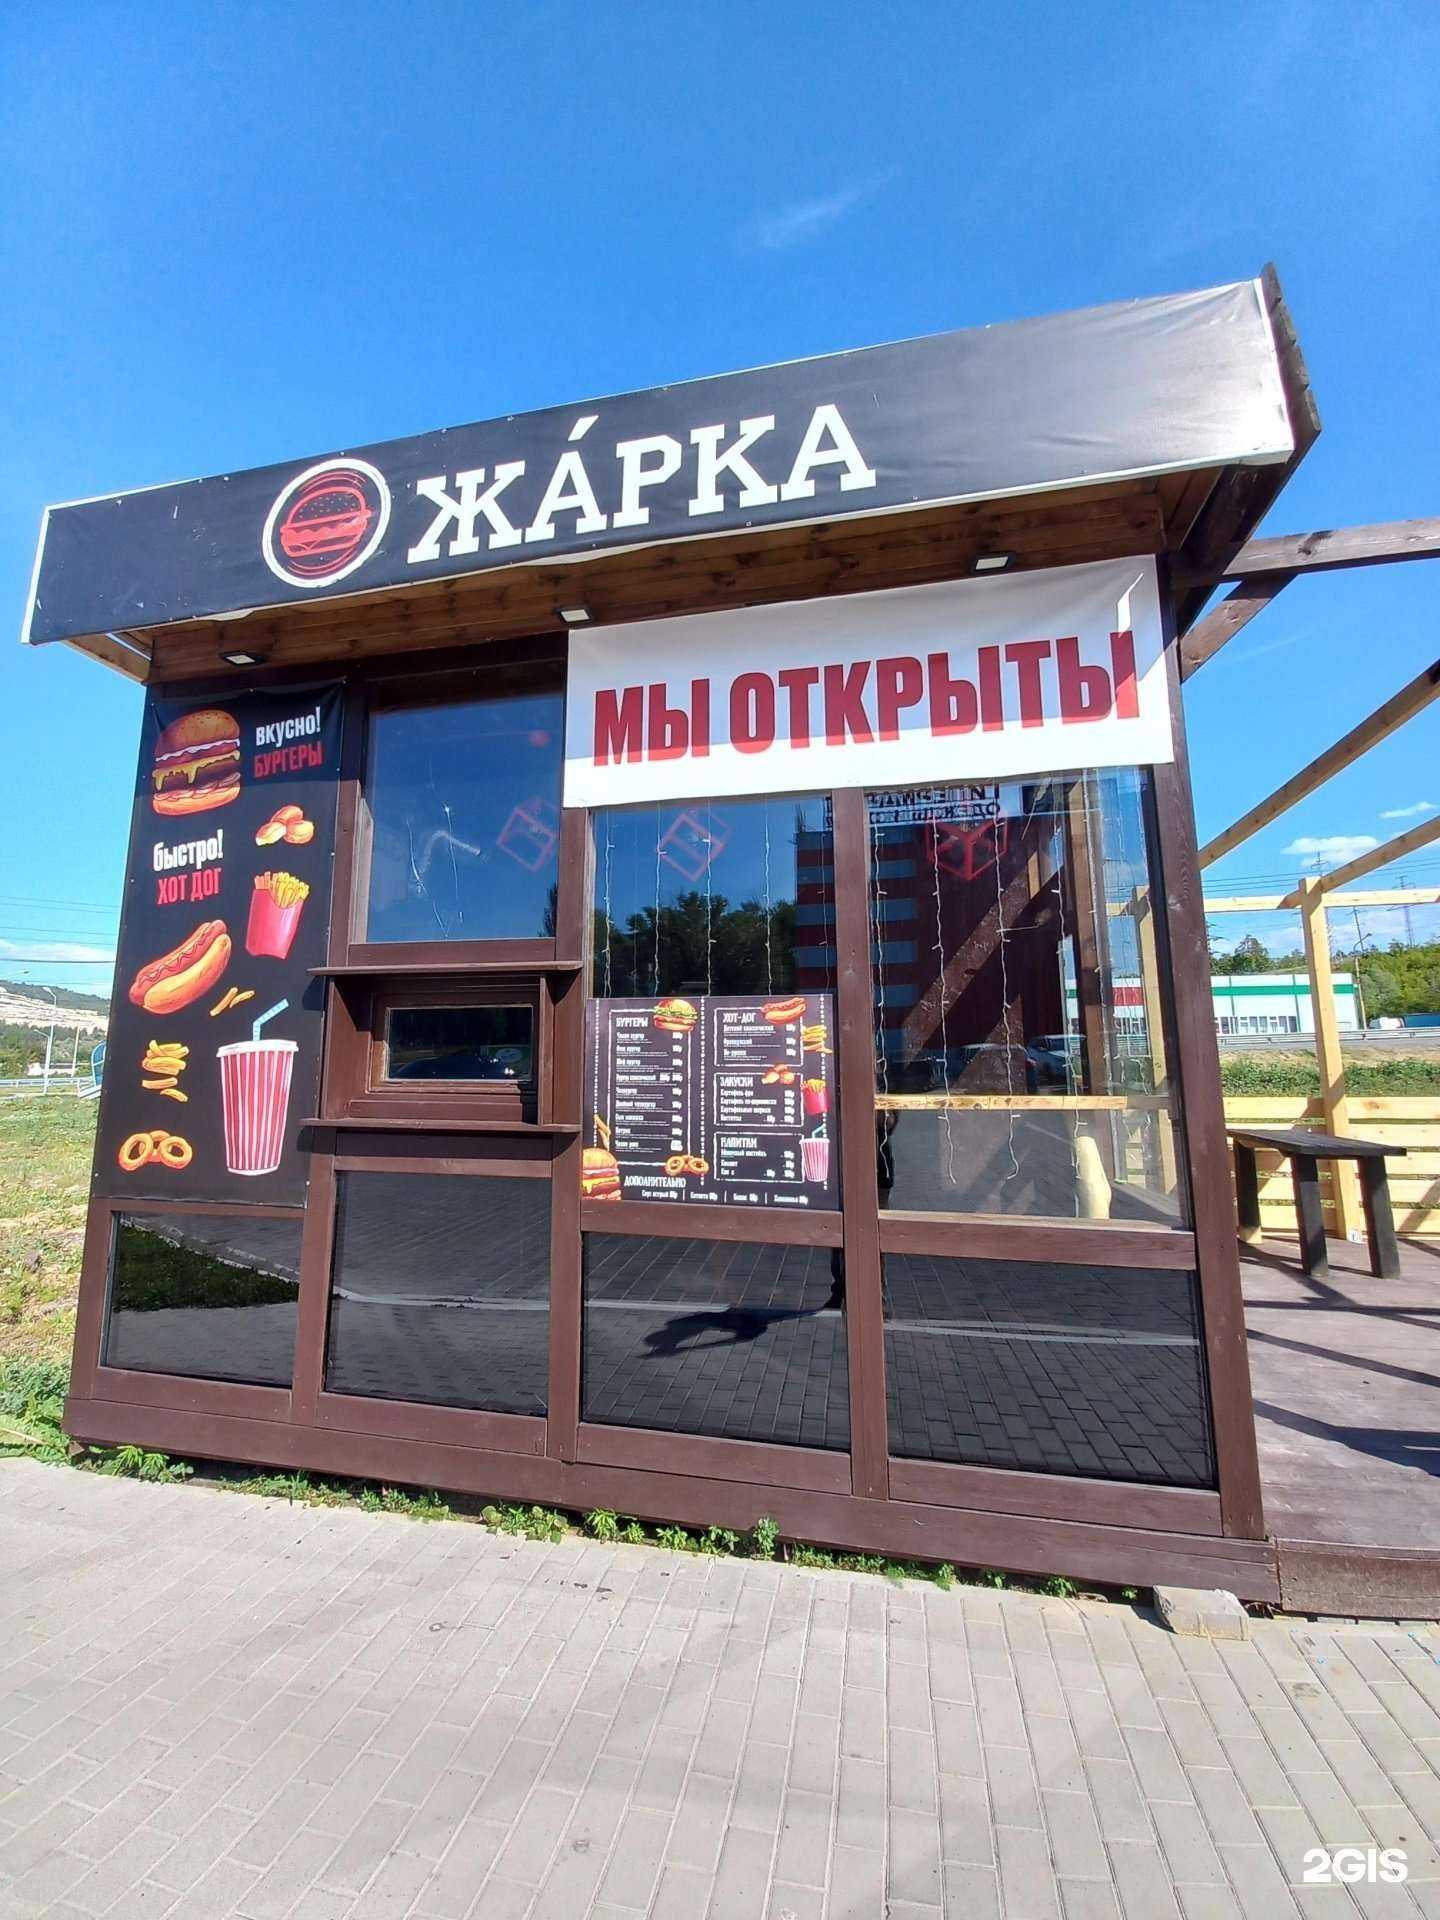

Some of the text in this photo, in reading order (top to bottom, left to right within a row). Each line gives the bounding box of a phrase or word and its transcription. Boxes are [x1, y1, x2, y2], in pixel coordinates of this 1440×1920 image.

[593, 631, 1140, 766] МЫ ОТКРЫТЫ
[254, 741, 323, 778] БУРГЕРЫ
[153, 829, 224, 872] быстро!
[157, 867, 222, 905] ХОТ ДОГ
[616, 1016, 649, 1028] БУРГЕРЫ
[722, 1012, 757, 1024] ХОТ-ДОГ
[719, 1076, 754, 1087] ЗАКУСКИ
[720, 1136, 758, 1149] НАПИТКИ
[624, 1175, 687, 1188] ДОПОЛНИТЕЛЬНО
